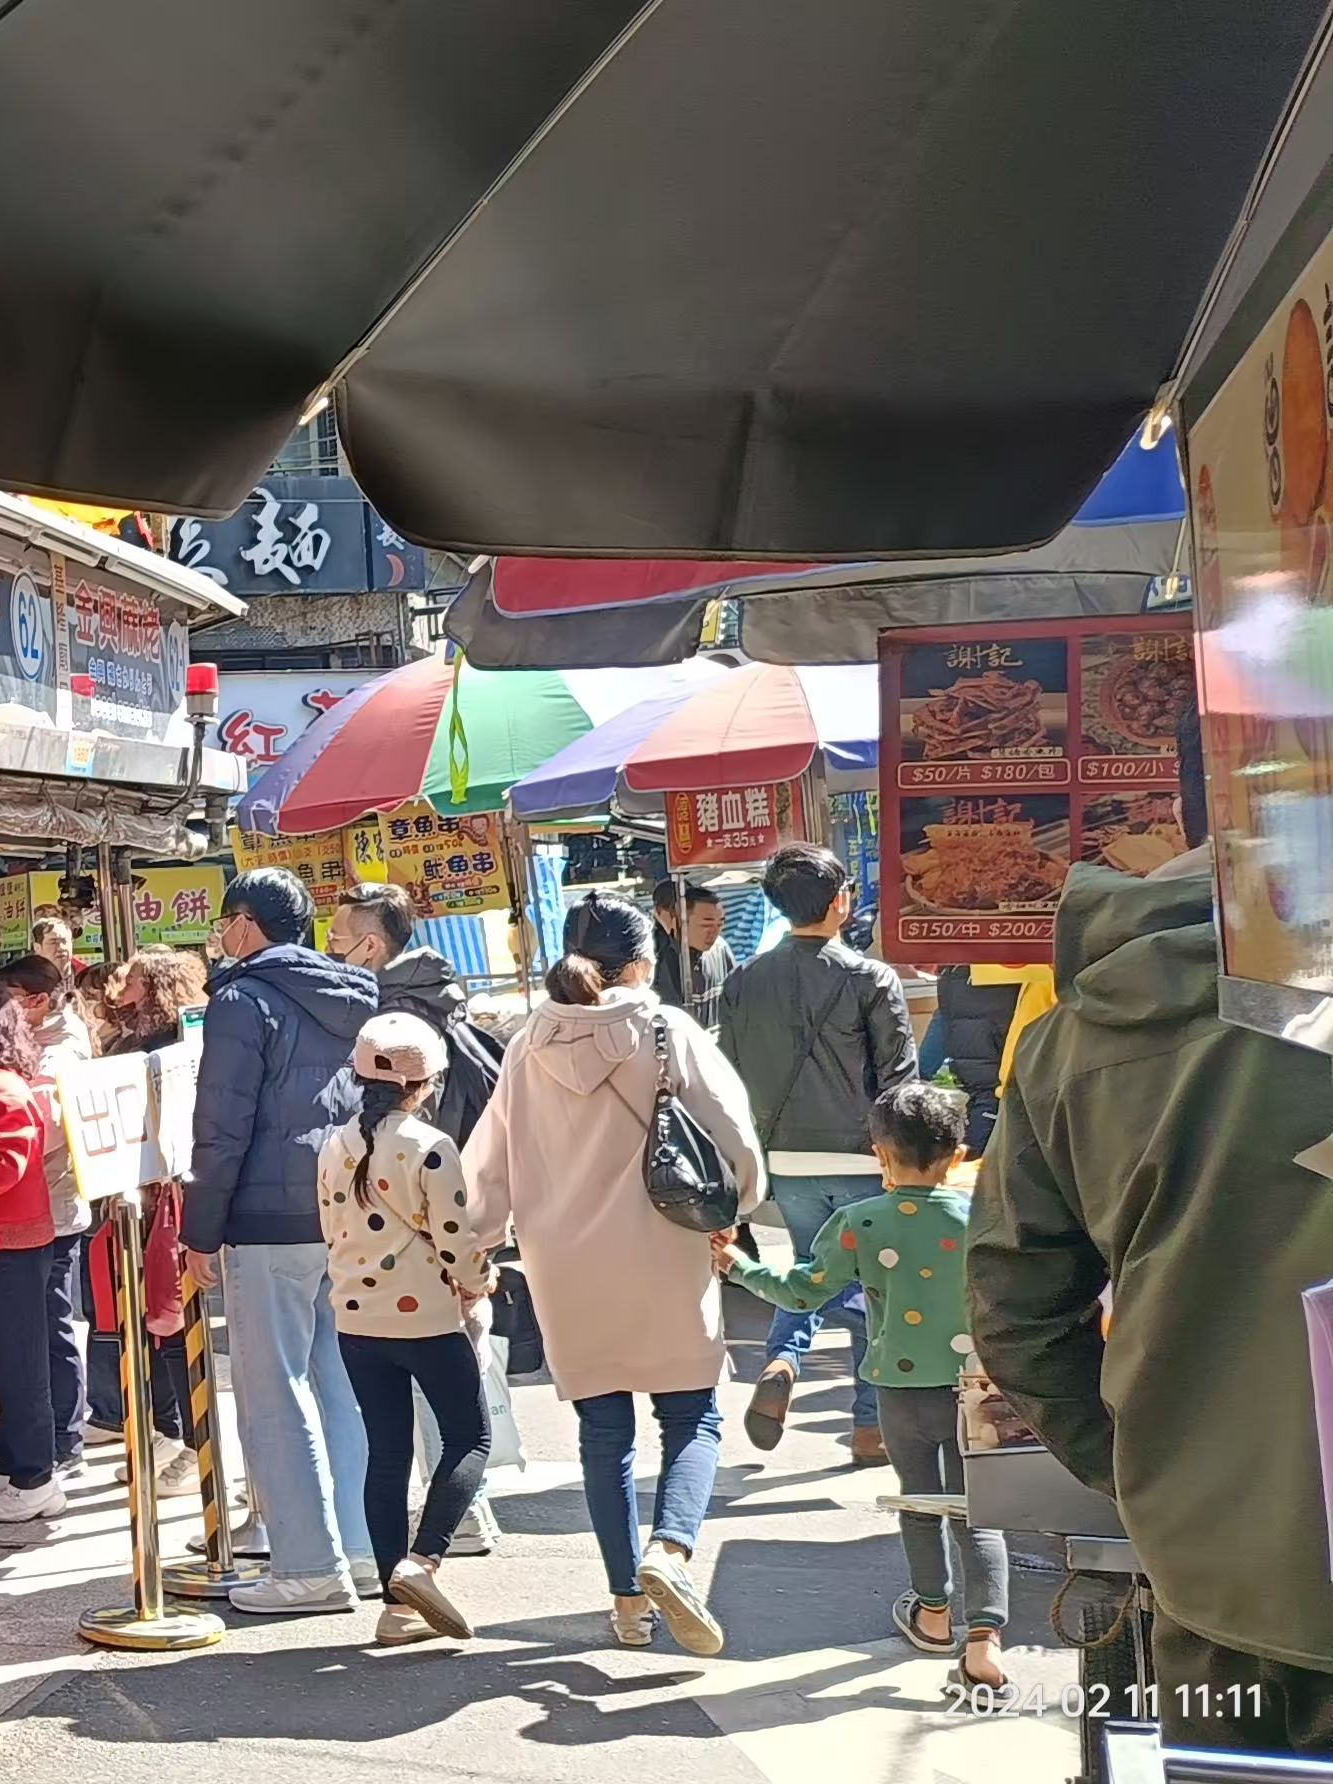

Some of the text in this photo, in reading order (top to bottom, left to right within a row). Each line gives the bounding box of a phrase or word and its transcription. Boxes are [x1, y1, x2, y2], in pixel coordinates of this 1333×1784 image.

[18, 591, 39, 660] 62
[945, 644, 1023, 669] 謝記
[912, 764, 1055, 783] $50/片 $180/包
[695, 786, 771, 833] 豬血糕
[907, 921, 981, 938] $150/中
